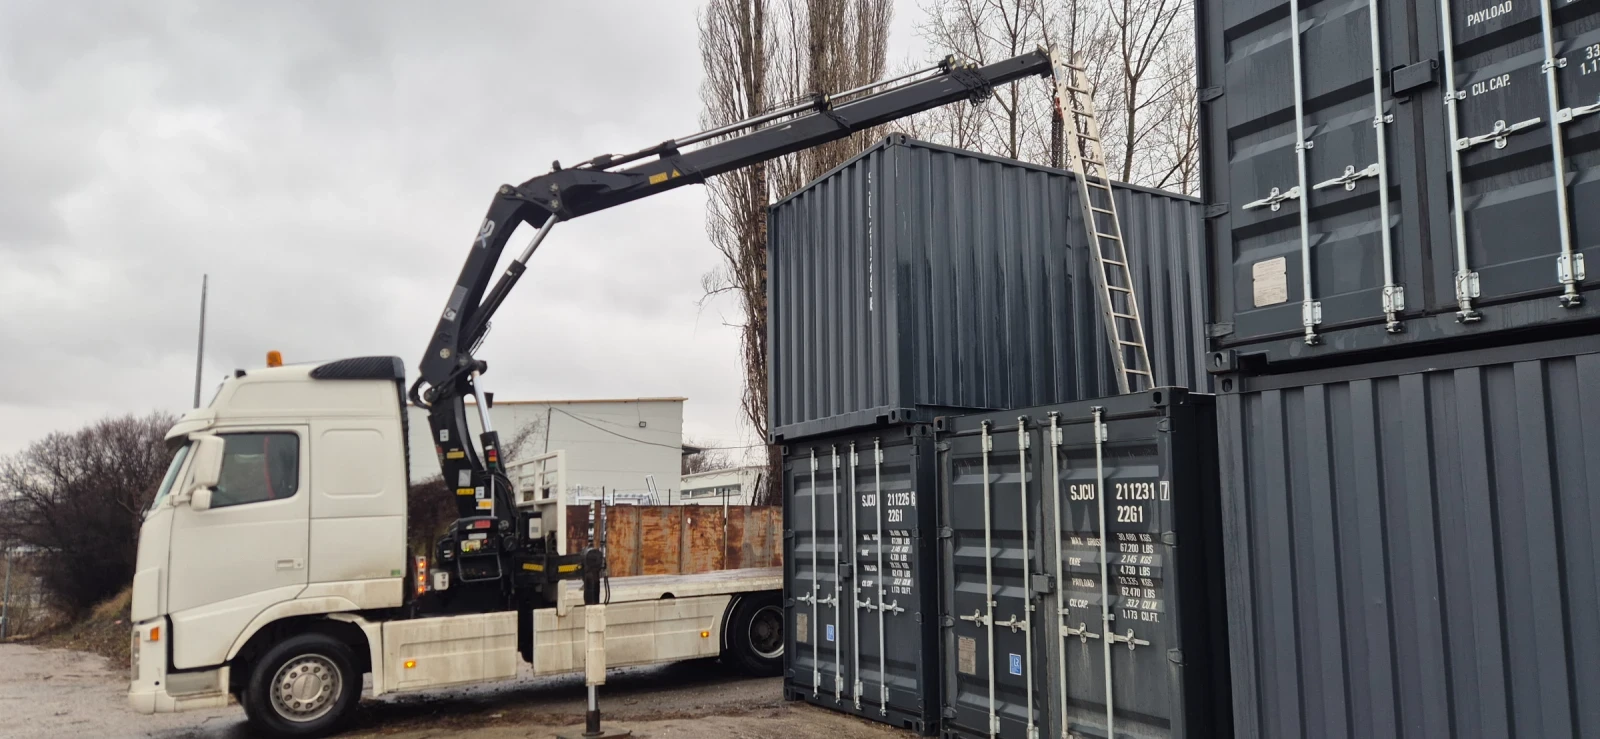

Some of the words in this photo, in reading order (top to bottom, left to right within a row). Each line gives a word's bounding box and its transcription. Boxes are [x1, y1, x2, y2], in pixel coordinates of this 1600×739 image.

[1467, 1, 1513, 27] PAYLOAD
[1472, 81, 1488, 96] CU.
[1490, 73, 1511, 91] CAP.
[888, 492, 910, 506] 211225
[1071, 483, 1095, 501] SJCU
[1116, 482, 1155, 500] 211231
[1161, 481, 1169, 500] 7
[1118, 505, 1143, 523] 22G1
[1143, 544, 1154, 554] LBS
[1140, 566, 1151, 577] LBS
[1144, 588, 1156, 599] LBS
